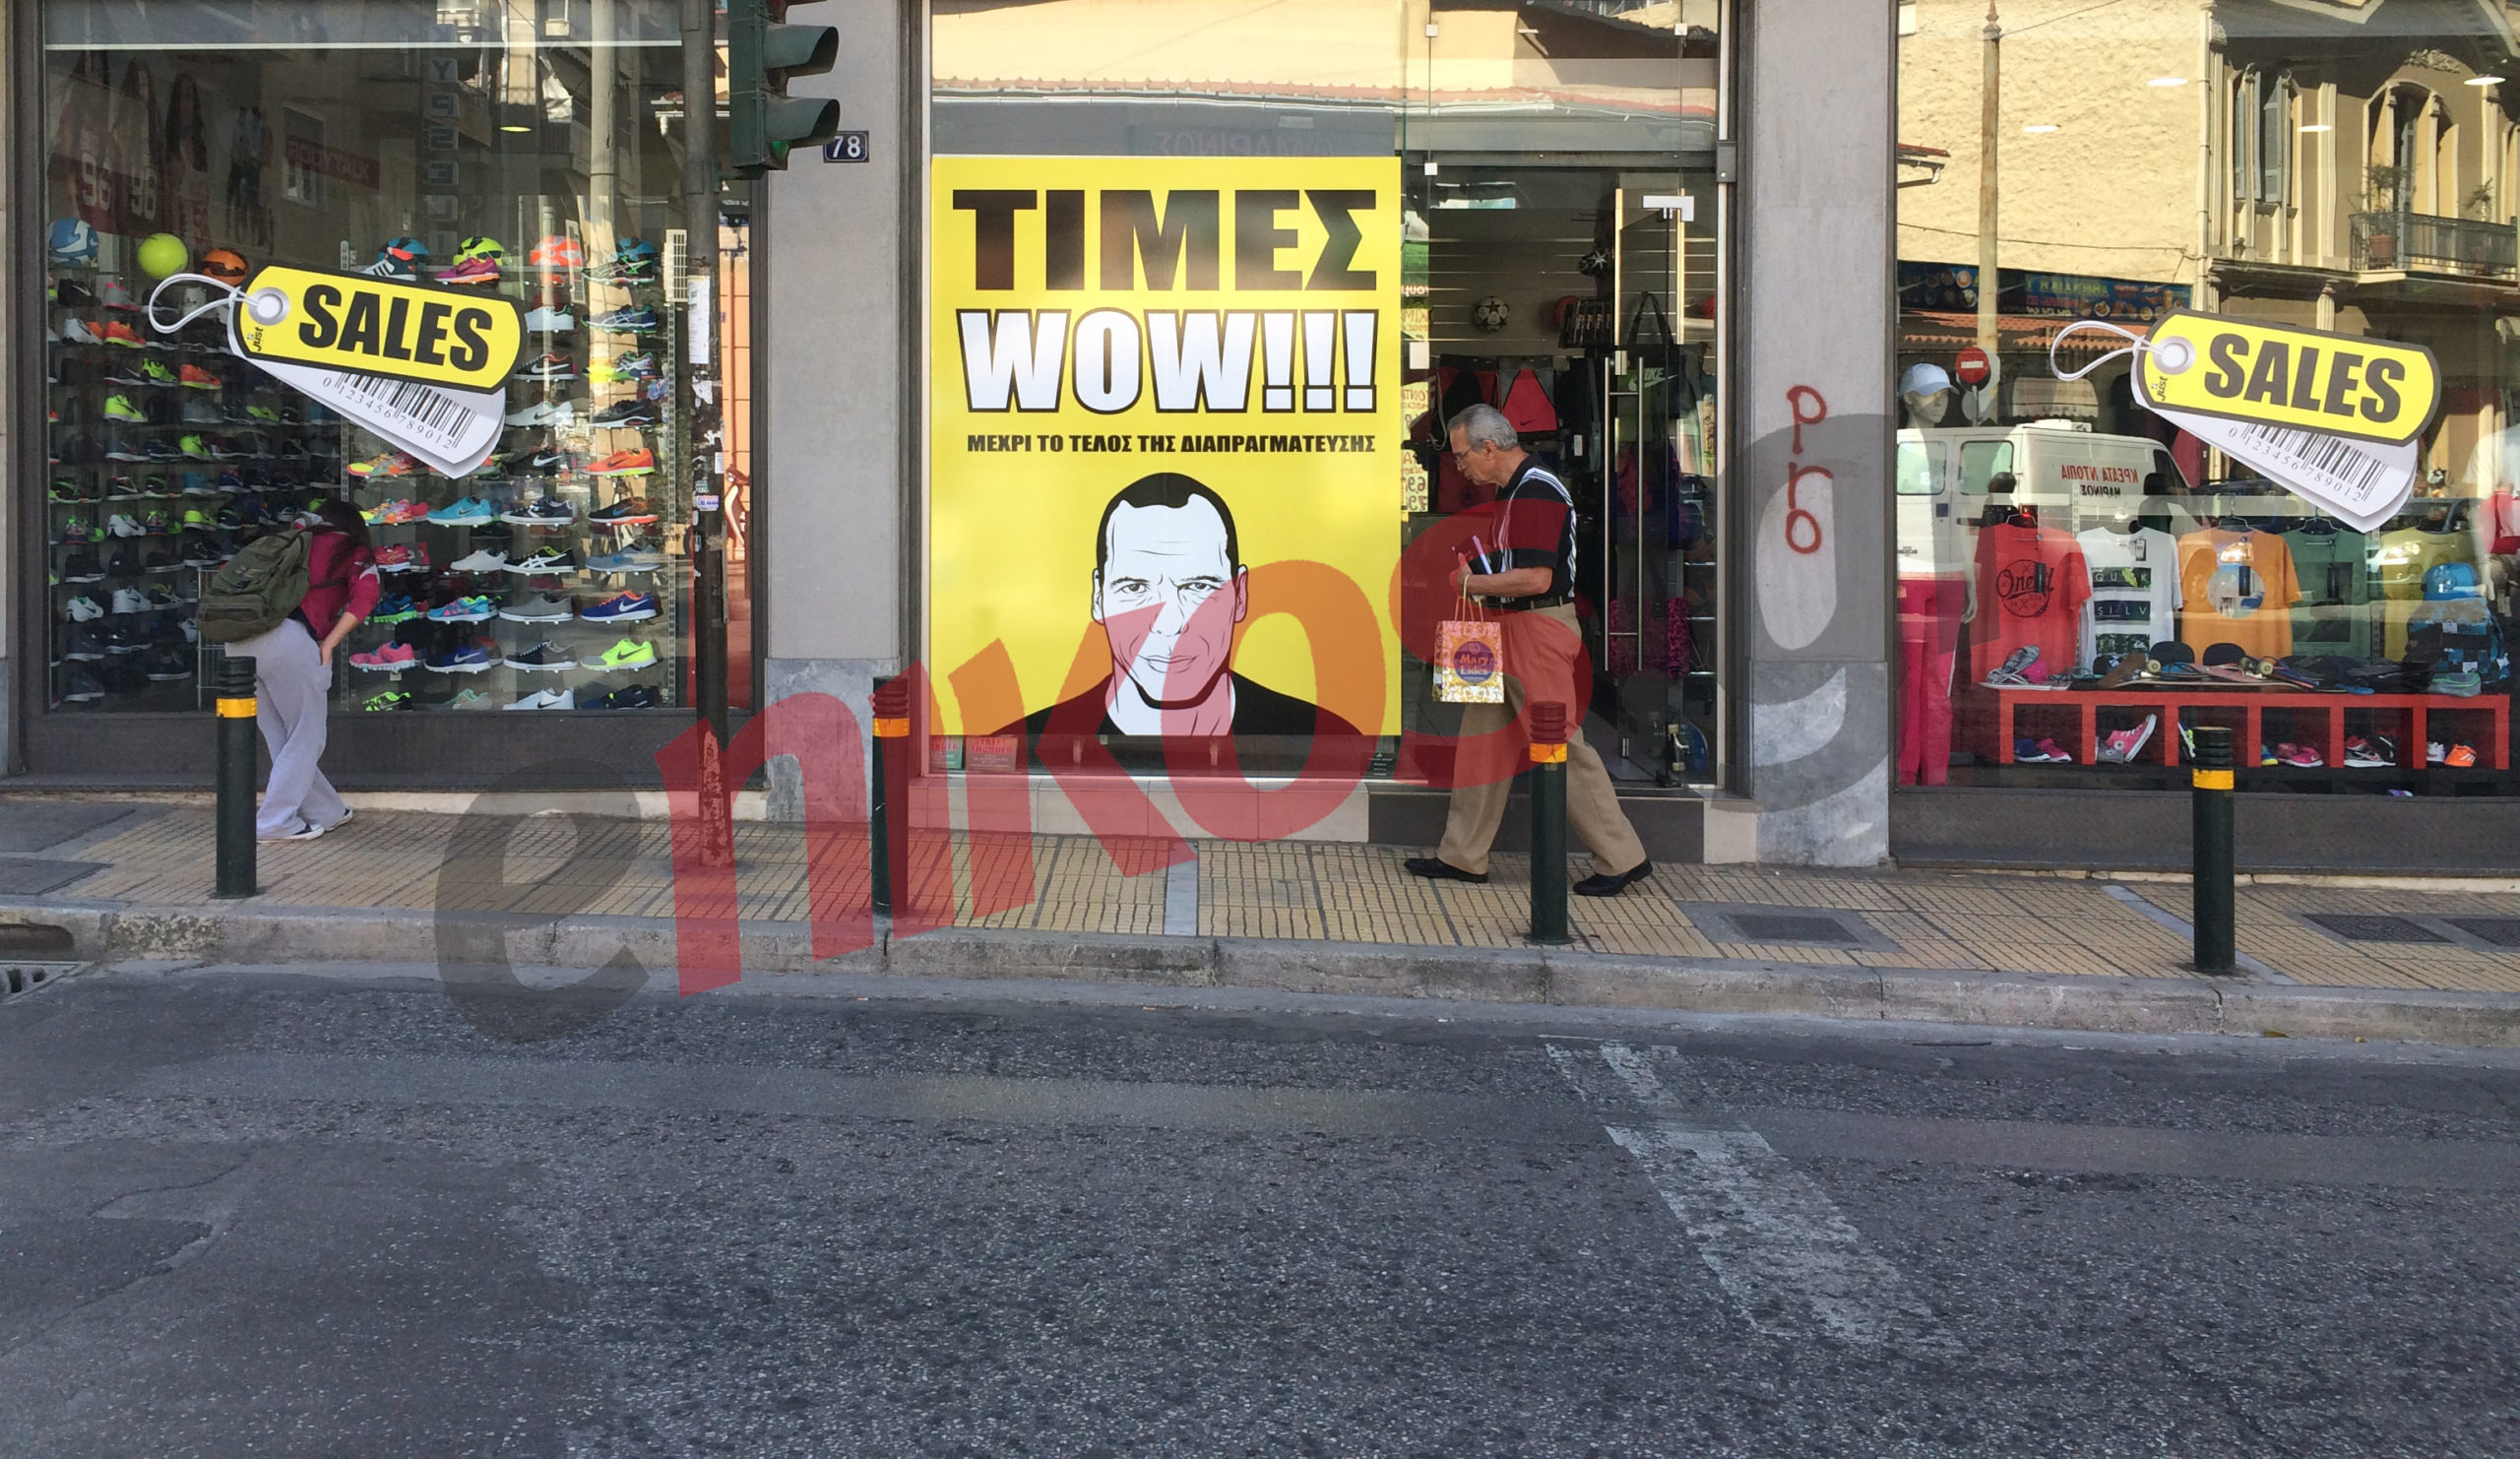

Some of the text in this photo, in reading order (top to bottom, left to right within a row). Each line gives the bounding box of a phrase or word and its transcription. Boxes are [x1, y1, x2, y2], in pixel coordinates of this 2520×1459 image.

[833, 135, 861, 159] 78
[953, 190, 1376, 290] ΤΙΜΕΣ
[253, 327, 264, 351] just
[299, 285, 492, 371] SALES
[956, 308, 1378, 414] WOW!!!
[2157, 376, 2169, 401] just
[2205, 334, 2404, 422] SALES
[968, 435, 1374, 452] ΜΕΧΡΙ ΤΟ ΤΕΛΟΣ ΤΗΣ ΔΙΑΠΡΑΓΜΑΤΕΥΣΗΣ
[2095, 572, 2148, 582] QUK
[1460, 654, 1489, 666] Mary
